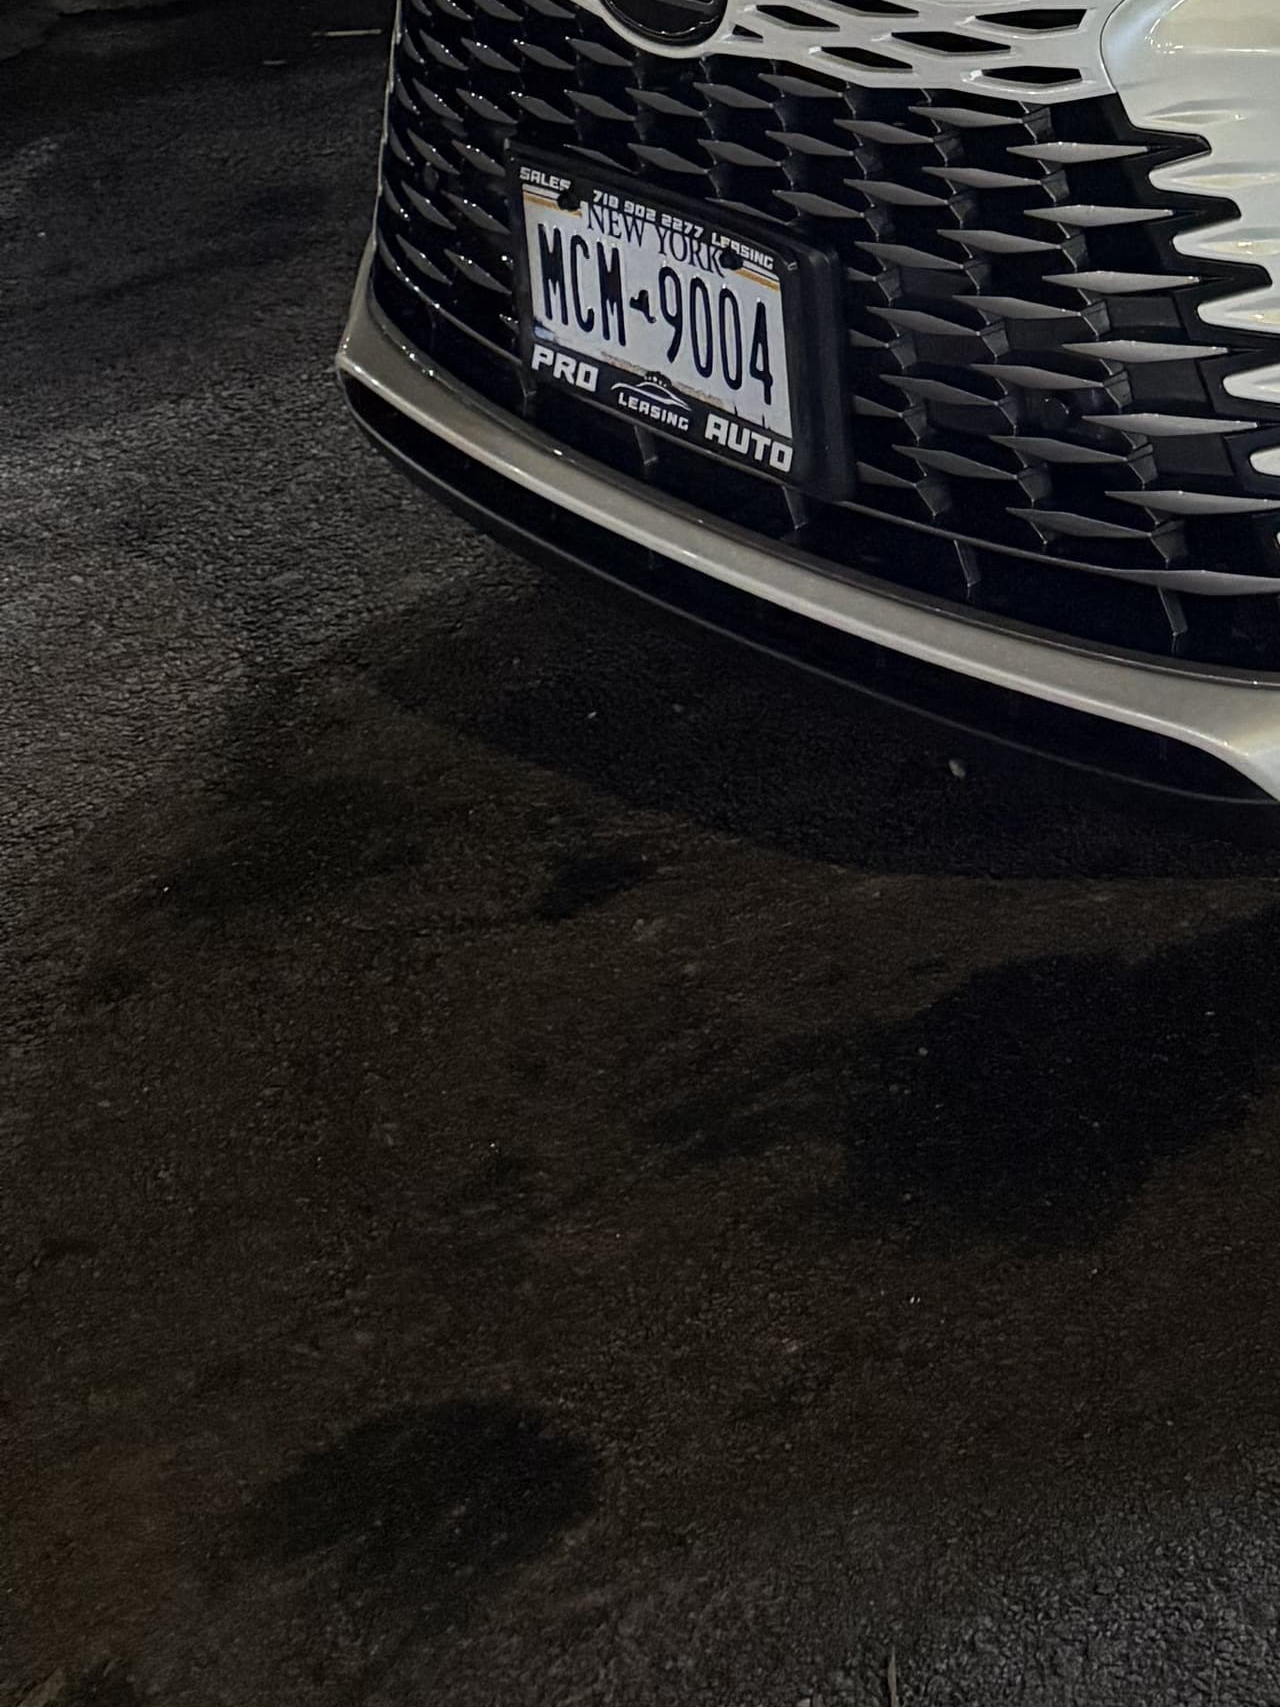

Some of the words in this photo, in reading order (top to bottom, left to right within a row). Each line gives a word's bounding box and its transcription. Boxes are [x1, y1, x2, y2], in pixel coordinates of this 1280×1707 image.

[519, 166, 571, 191] SALES
[593, 189, 619, 209] 718
[624, 201, 657, 222] 902
[661, 213, 704, 239] 2277
[587, 202, 645, 248] NEW
[655, 223, 726, 278] YORK
[538, 222, 627, 347] MCM
[658, 265, 774, 406] 9004
[531, 344, 599, 392] PRO
[618, 391, 689, 432] LEASING
[705, 413, 794, 473] AUTO
